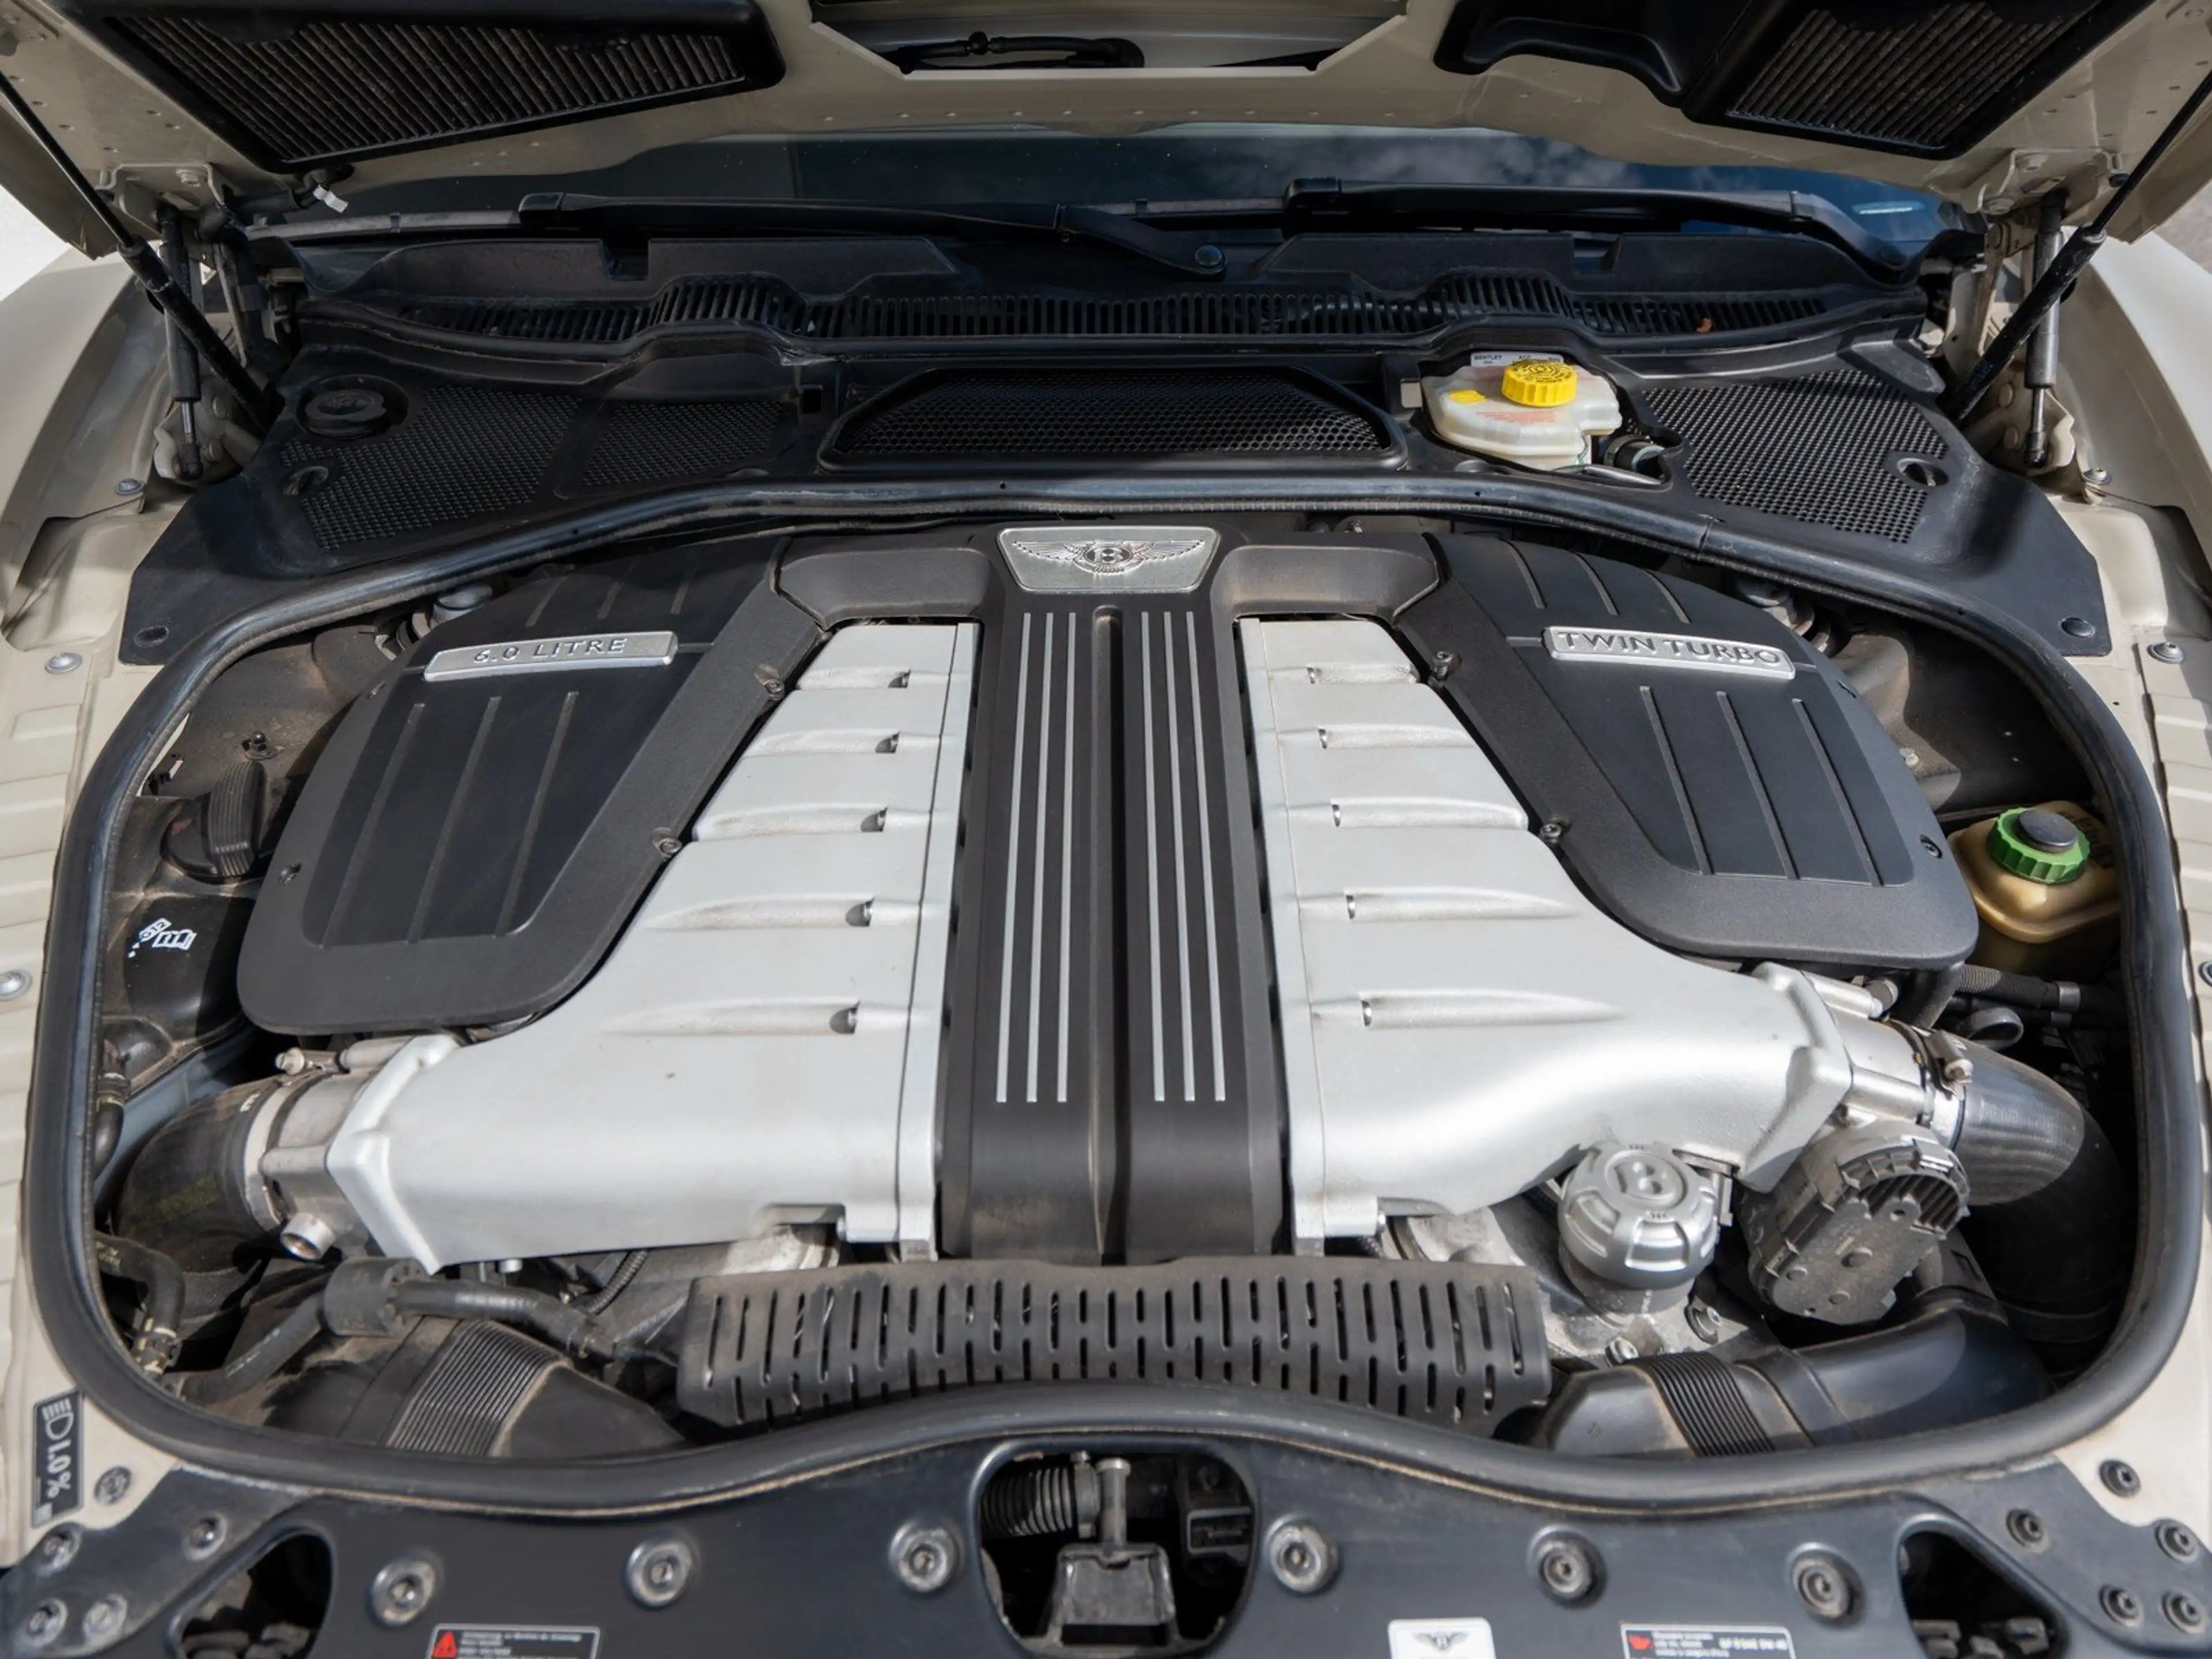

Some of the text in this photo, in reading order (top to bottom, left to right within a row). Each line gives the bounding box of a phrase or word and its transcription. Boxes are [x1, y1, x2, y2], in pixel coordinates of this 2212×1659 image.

[474, 638, 627, 663] 6.0 LITRE
[1558, 632, 1781, 664] TWIN TURBO
[47, 1440, 71, 1498] 1.0%
